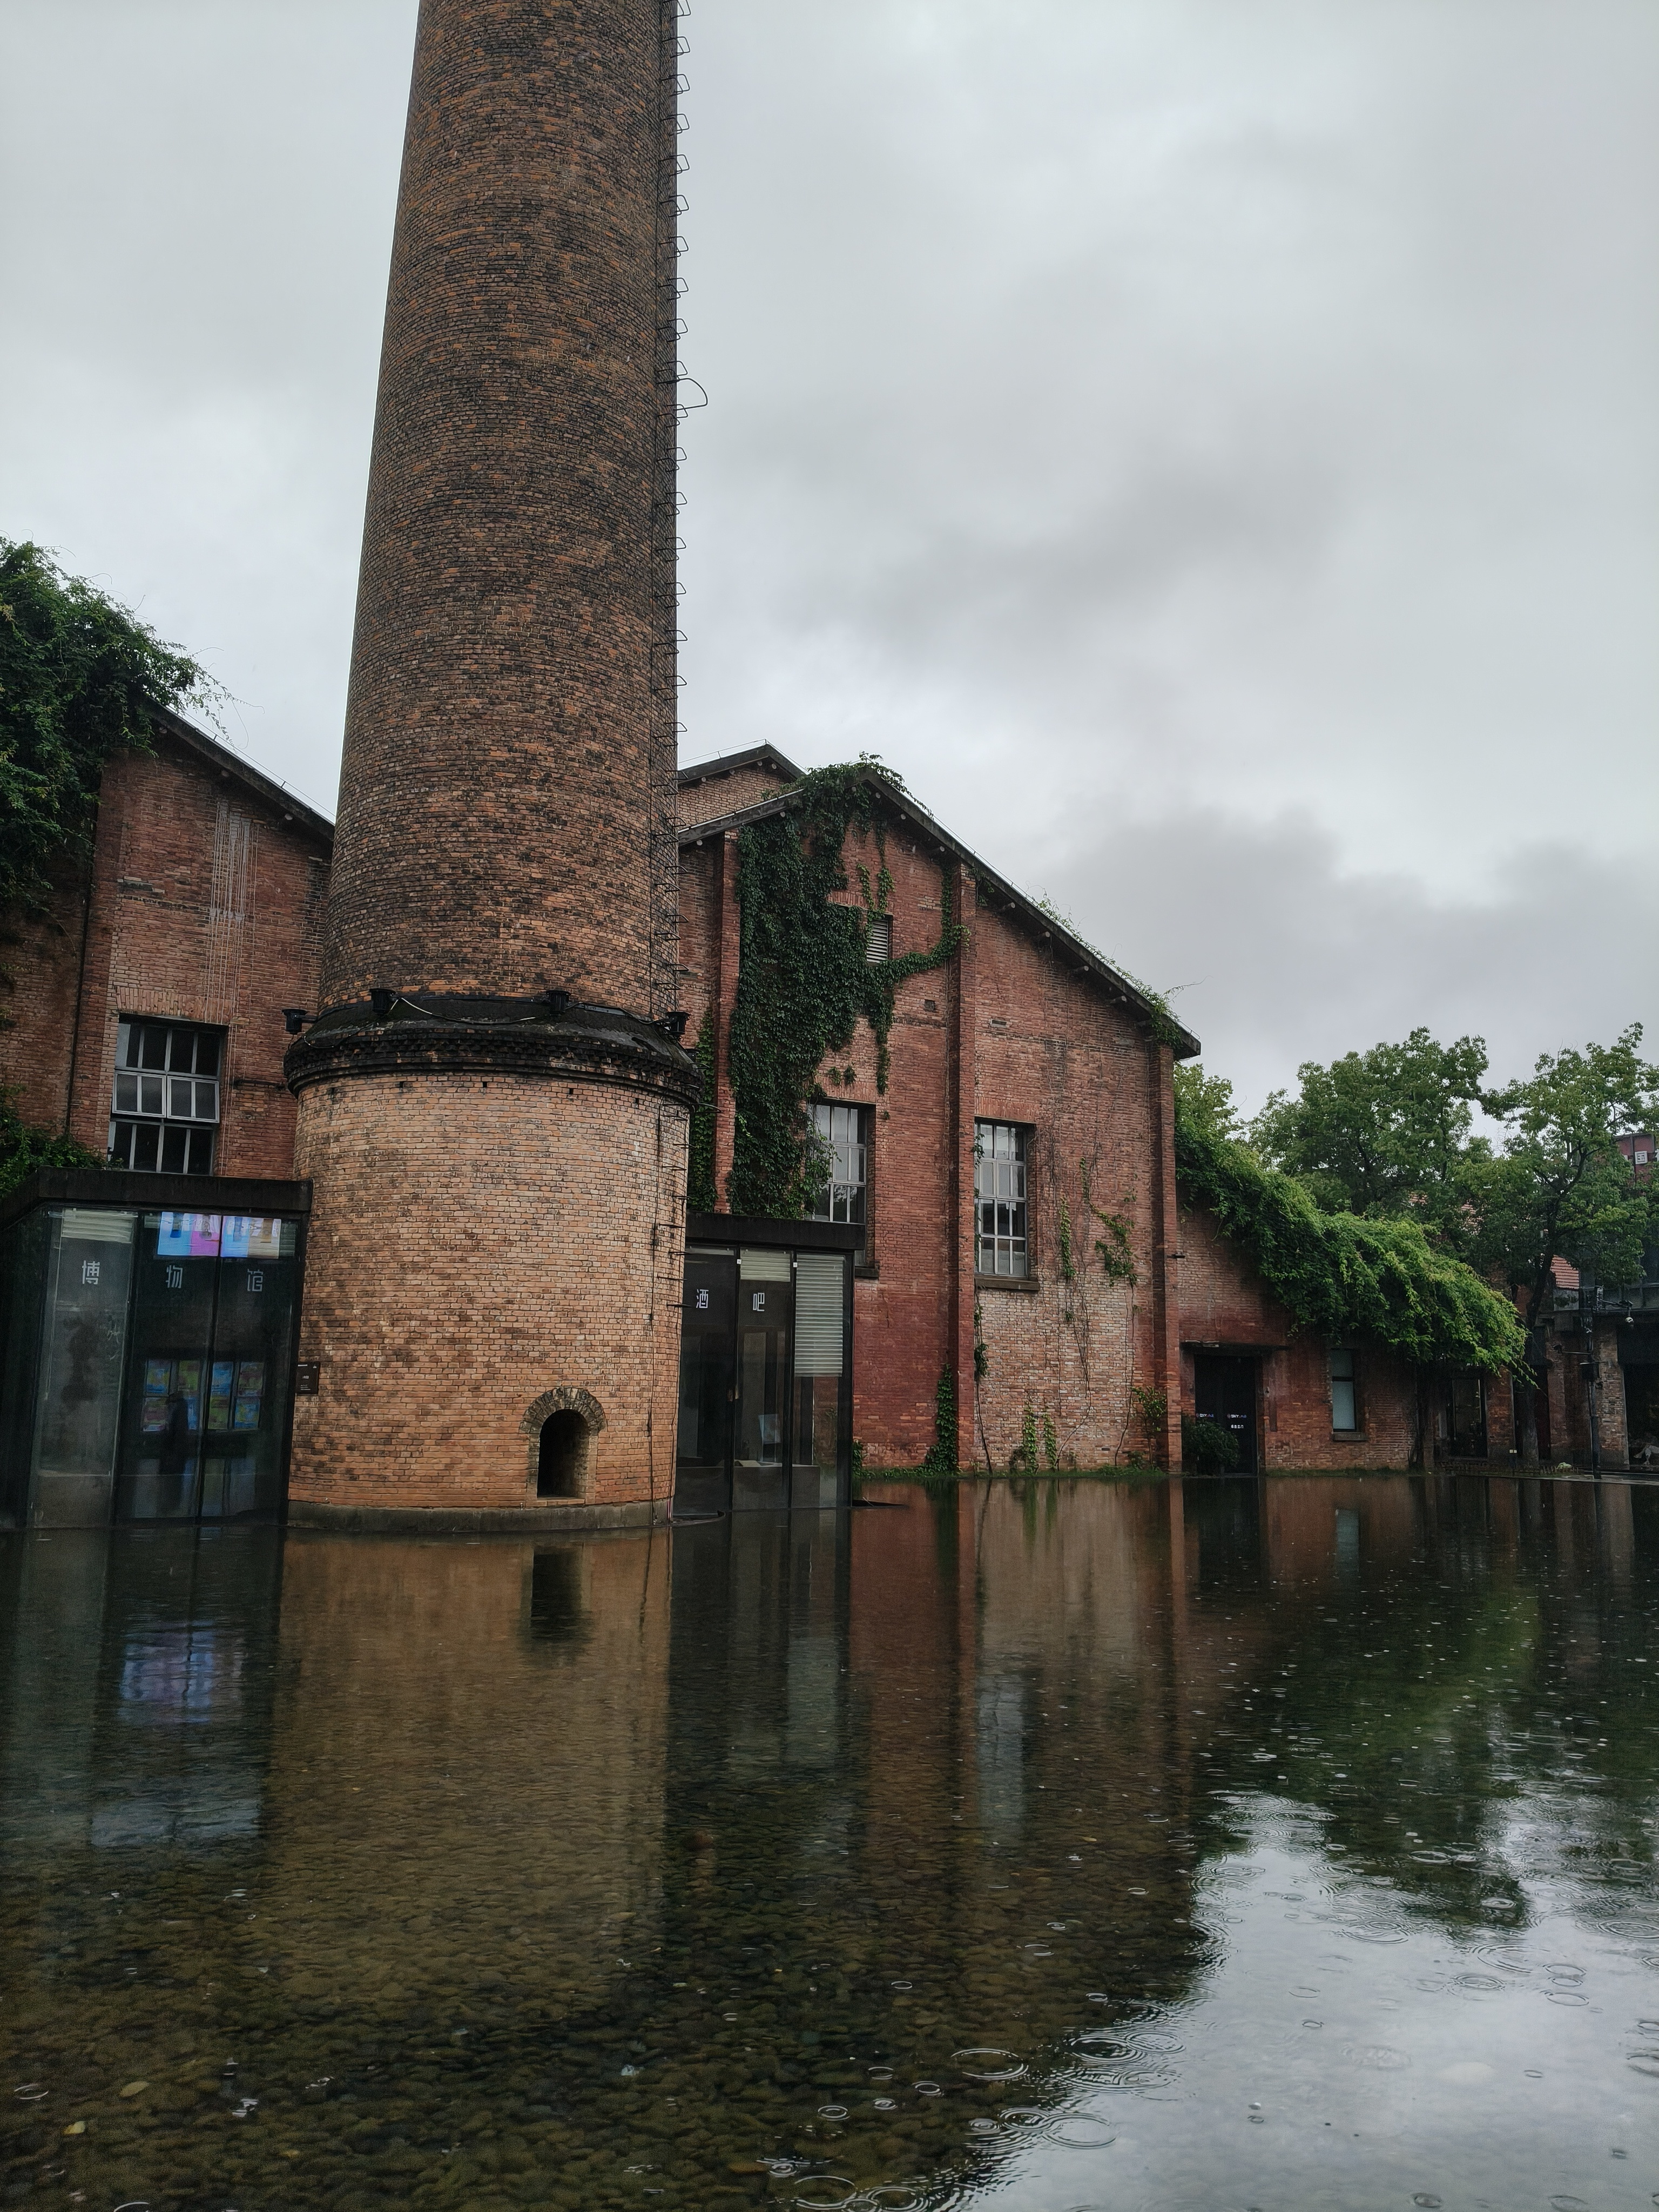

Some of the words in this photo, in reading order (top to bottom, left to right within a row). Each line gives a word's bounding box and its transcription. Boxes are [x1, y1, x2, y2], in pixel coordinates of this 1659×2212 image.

[82, 1260, 264, 1292] 博物馆
[696, 1289, 765, 1311] 酒吧
